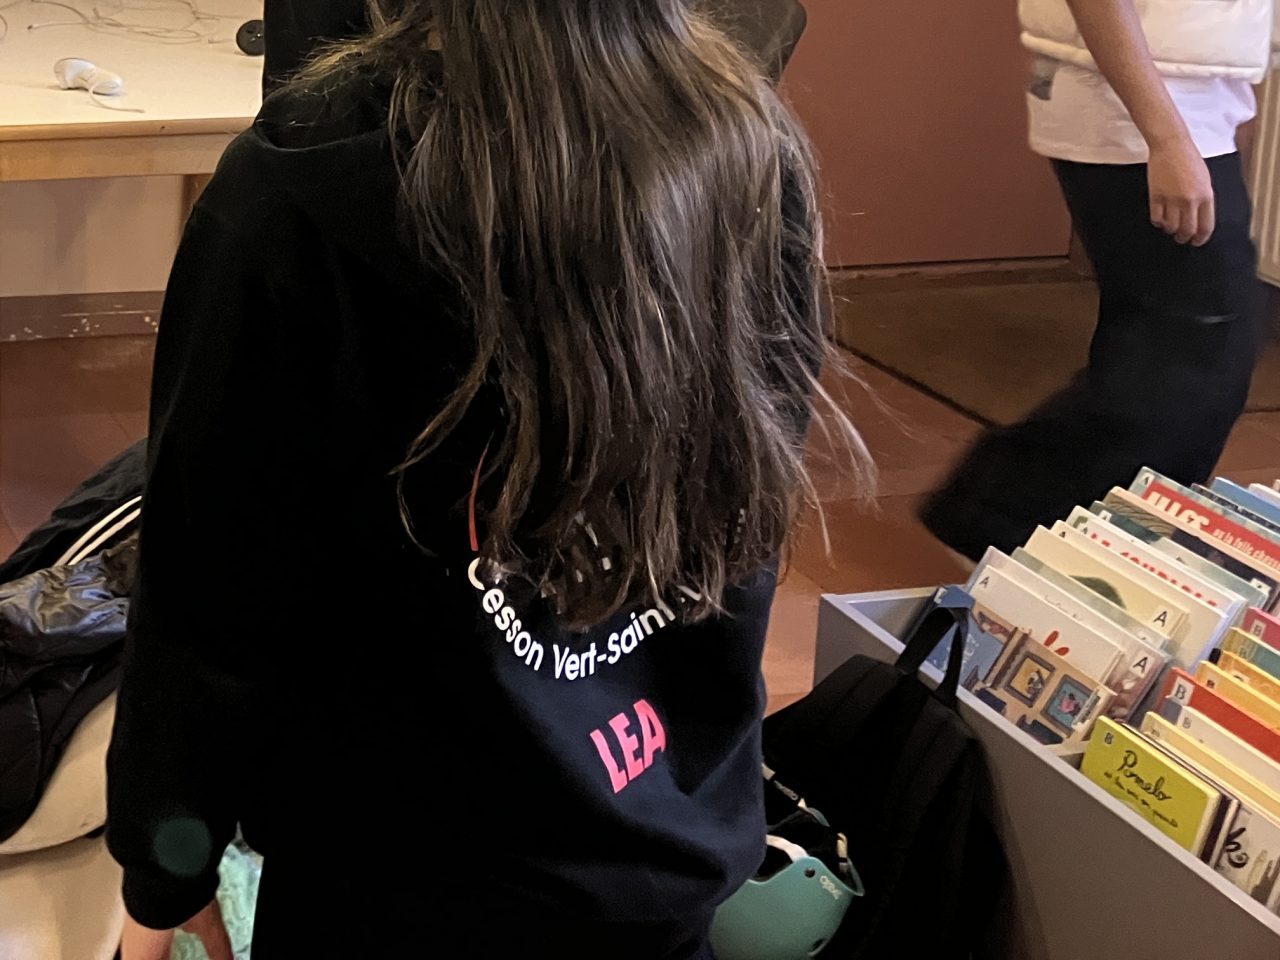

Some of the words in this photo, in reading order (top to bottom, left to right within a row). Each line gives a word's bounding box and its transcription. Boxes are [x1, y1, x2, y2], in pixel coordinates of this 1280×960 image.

[553, 587, 694, 680] Vert-Saint
[1153, 610, 1168, 628] A
[1132, 656, 1148, 674] A
[1175, 684, 1187, 700] B
[589, 698, 667, 793] LEA
[1117, 750, 1172, 801] Pomelo
